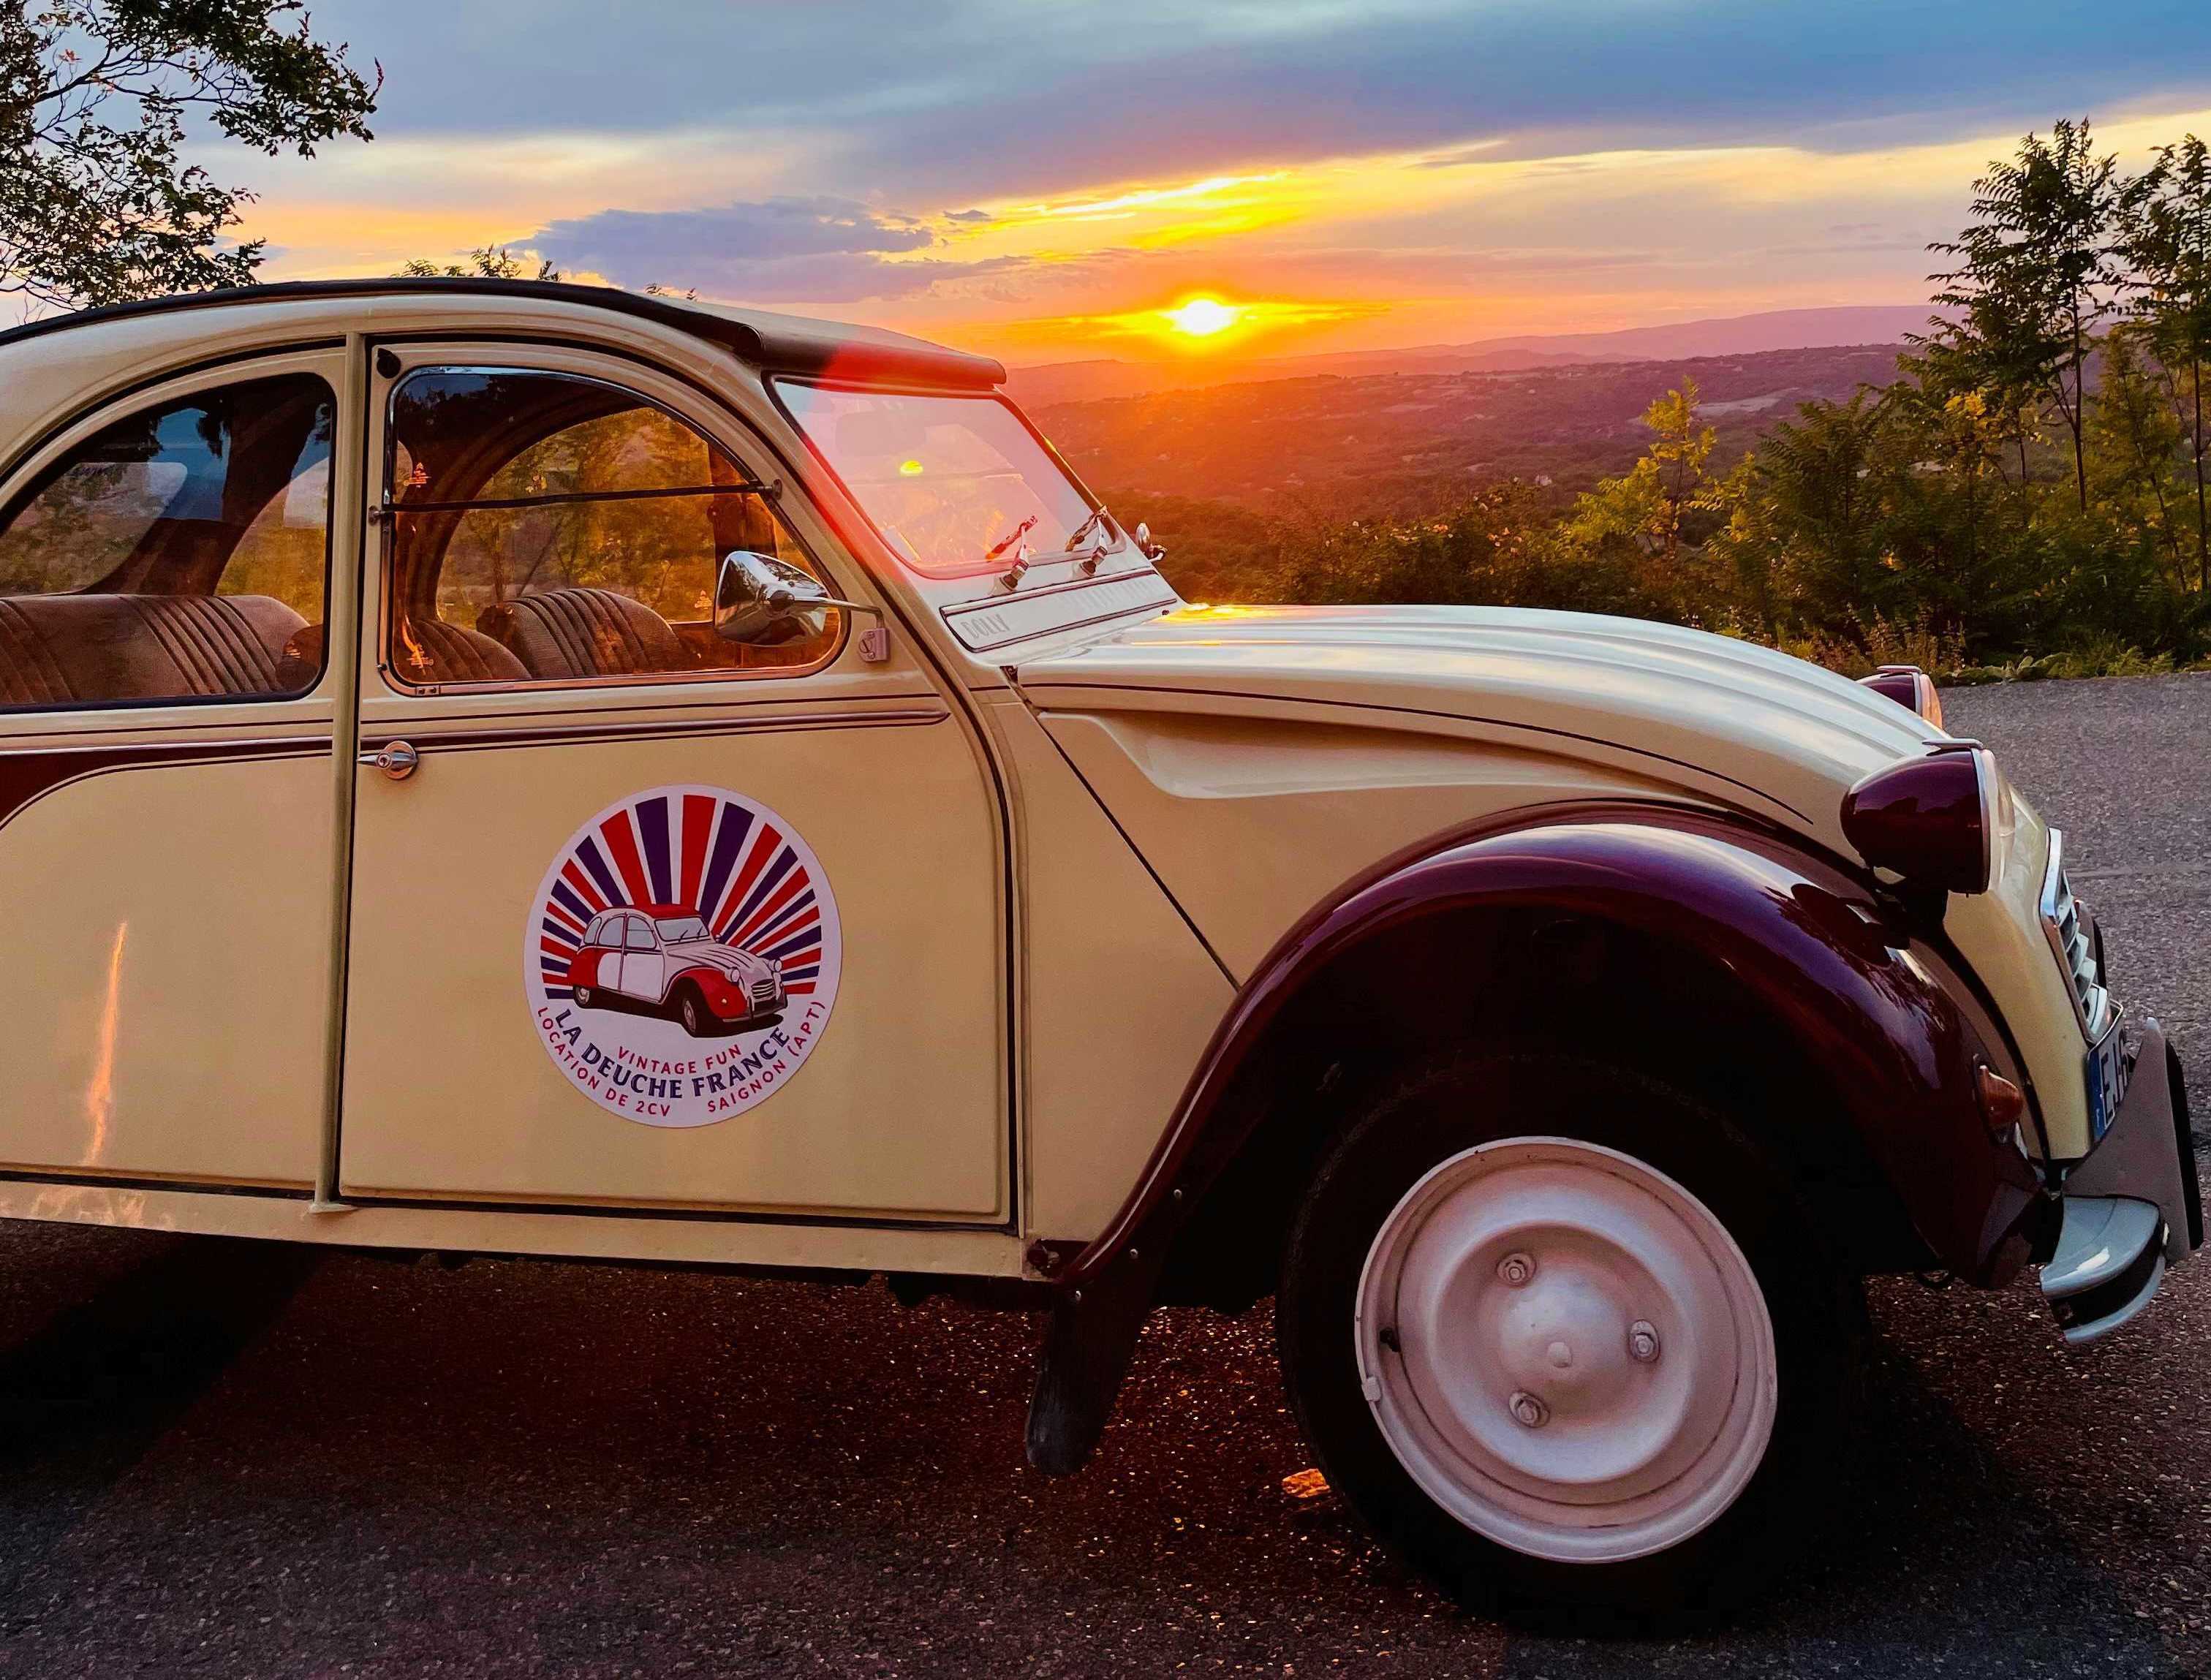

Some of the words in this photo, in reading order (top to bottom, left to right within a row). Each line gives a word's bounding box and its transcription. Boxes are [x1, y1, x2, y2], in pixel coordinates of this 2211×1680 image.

[960, 613, 1011, 638] DOLLY
[537, 1007, 600, 1090] LOCATION
[605, 1090, 628, 1107] DE
[635, 1101, 671, 1117] 2CV
[555, 1009, 583, 1046] LA
[581, 1043, 683, 1098] DEUCHE
[692, 1026, 790, 1097] FRANCE
[619, 1046, 696, 1075] VINTAGE
[706, 1044, 742, 1070] FUN
[707, 1061, 787, 1113] SAIGNON
[787, 1001, 826, 1056] (APT)
